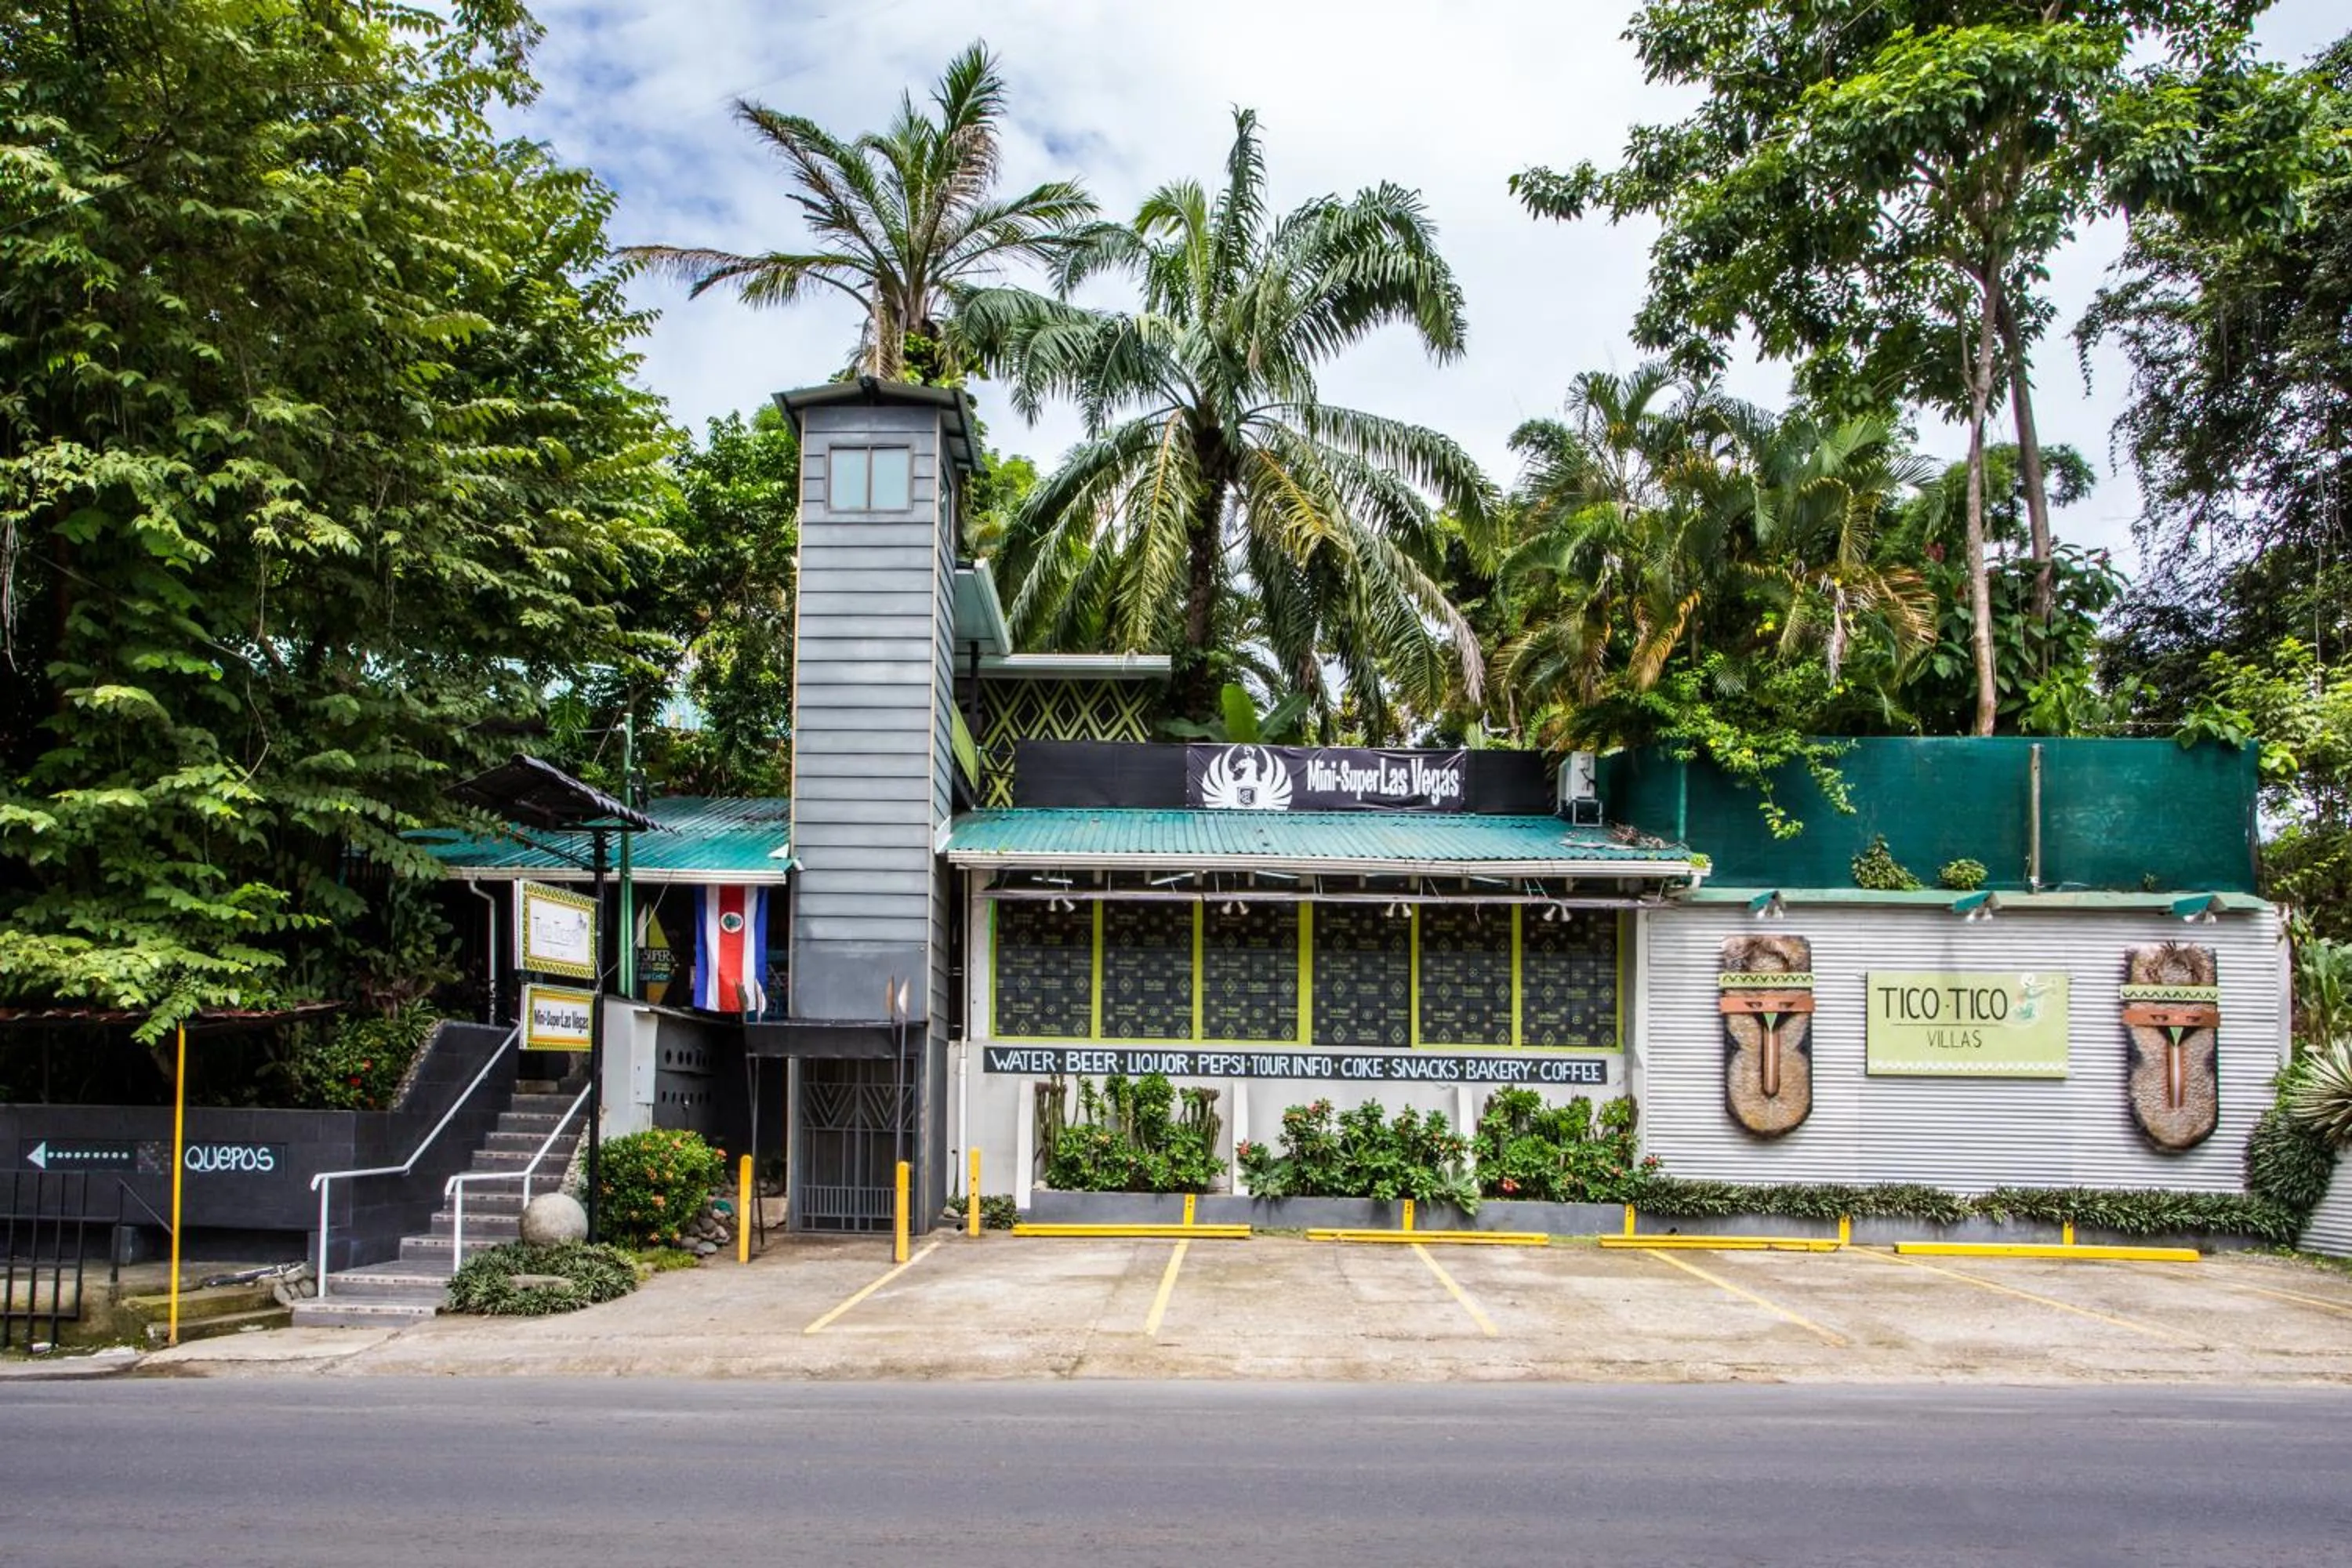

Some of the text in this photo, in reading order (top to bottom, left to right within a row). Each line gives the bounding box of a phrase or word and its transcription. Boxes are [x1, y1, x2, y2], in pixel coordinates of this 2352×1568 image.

[1380, 757, 1408, 797] Las
[1411, 758, 1460, 806] Vegas
[1877, 987, 2008, 1020] TICO TICO
[1927, 1029, 1982, 1048] VILLAS
[990, 1050, 1601, 1082] WATER BEER LIQUOR PEPSI TOUR INFO COKE SNACKS BAKERY COFFEE
